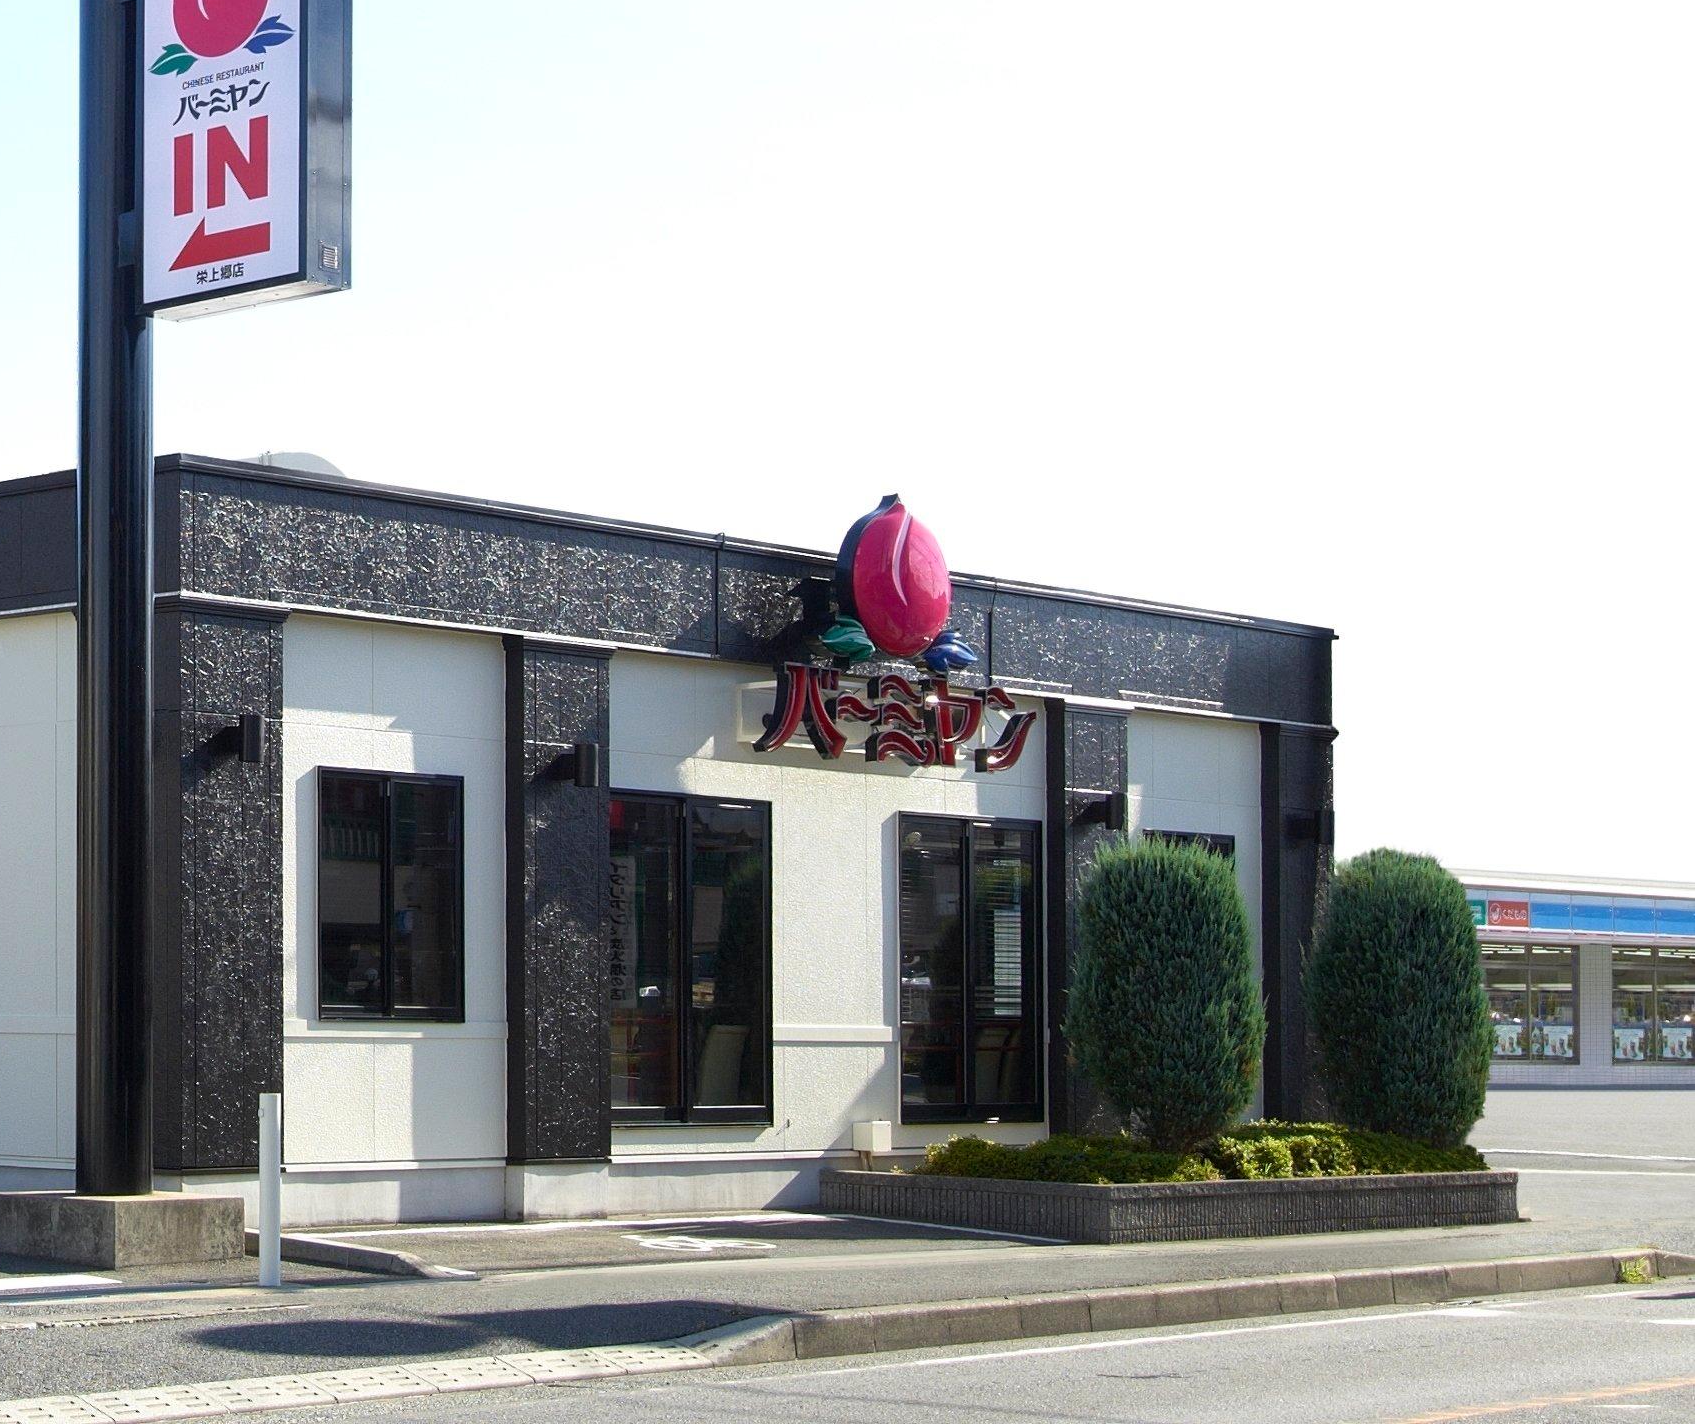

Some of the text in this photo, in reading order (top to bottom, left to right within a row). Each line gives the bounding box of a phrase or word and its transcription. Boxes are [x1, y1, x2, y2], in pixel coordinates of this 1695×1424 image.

[173, 79, 270, 126] バーミヤン
[182, 61, 265, 90] CHINESE RESTAURANT
[174, 115, 268, 216] IN
[753, 660, 1037, 773] バーミヤン
